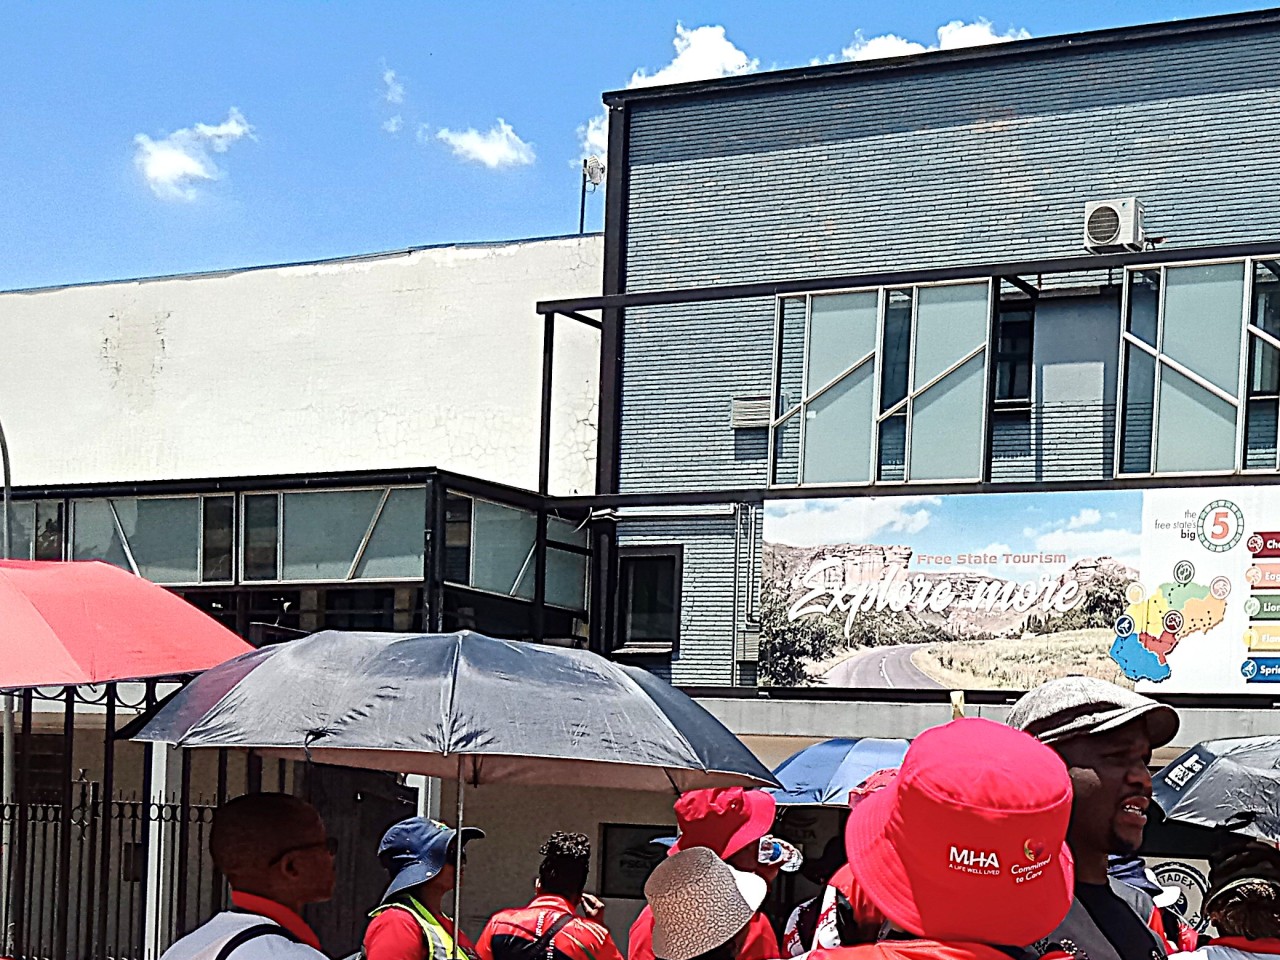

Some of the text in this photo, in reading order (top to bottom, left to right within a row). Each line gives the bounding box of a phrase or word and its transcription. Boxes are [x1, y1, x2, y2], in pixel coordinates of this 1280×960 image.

[1184, 509, 1197, 519] the
[1155, 520, 1171, 530] free
[1210, 511, 1230, 540] 5
[1181, 529, 1196, 541] big
[917, 552, 1067, 565] Free State Tourism
[788, 555, 1085, 640] Explore more
[949, 846, 1000, 868] MHA
